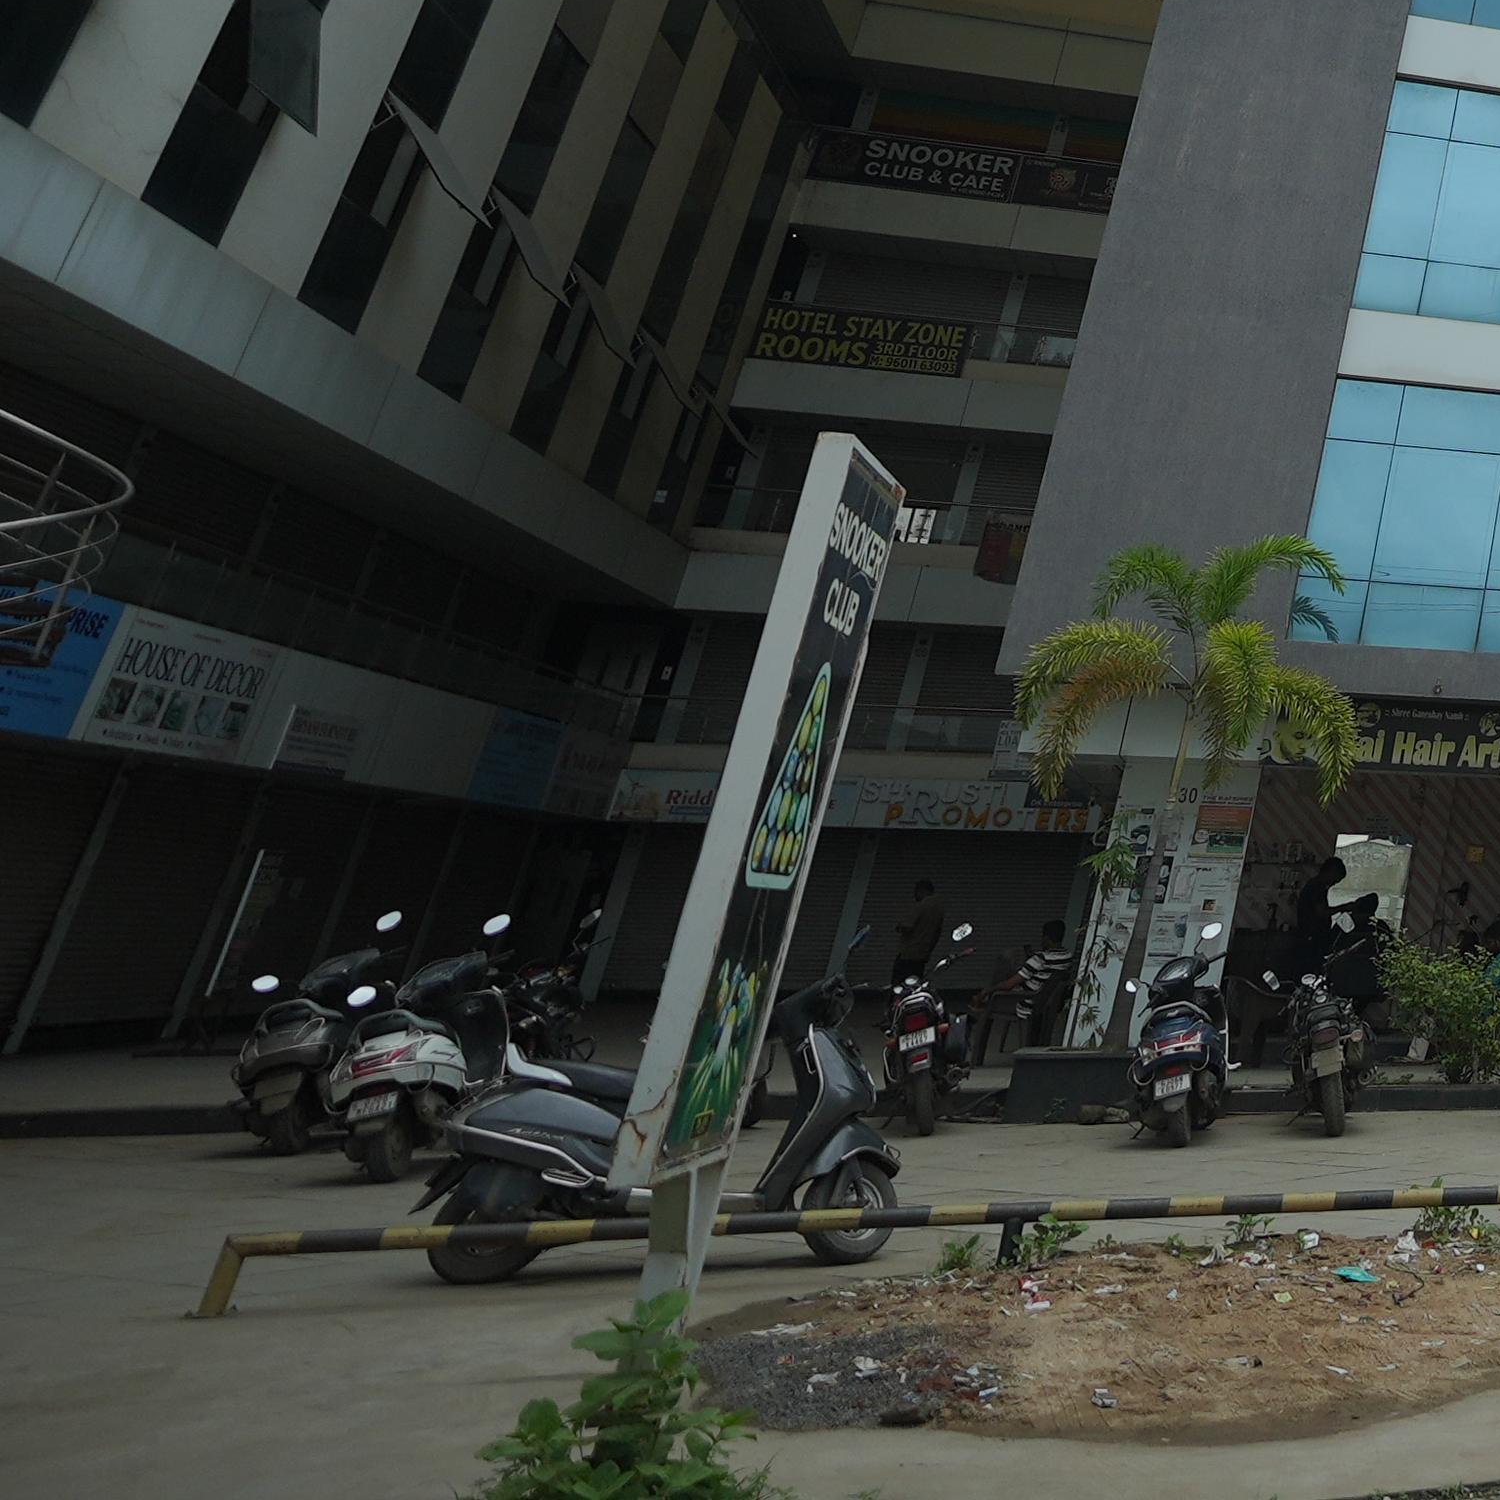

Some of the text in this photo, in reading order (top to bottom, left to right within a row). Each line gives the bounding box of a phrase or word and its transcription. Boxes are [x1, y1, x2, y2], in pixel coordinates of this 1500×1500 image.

[865, 139, 1014, 176] SNOOKER
[864, 161, 1004, 193] CLUB & CAFE
[762, 307, 967, 348] HOTEL STAY ZONE
[753, 332, 869, 366] ROOMS
[874, 342, 960, 362] 3RD FLOOR
[885, 356, 917, 370] 96011
[920, 359, 956, 374] 63093
[827, 501, 887, 578] SNOOKER
[822, 578, 860, 636] CLUB
[116, 638, 266, 700] HOUSE OF DECOR
[1358, 729, 1385, 763] ai
[1391, 731, 1456, 766] Hair
[1178, 787, 1198, 804] 30
